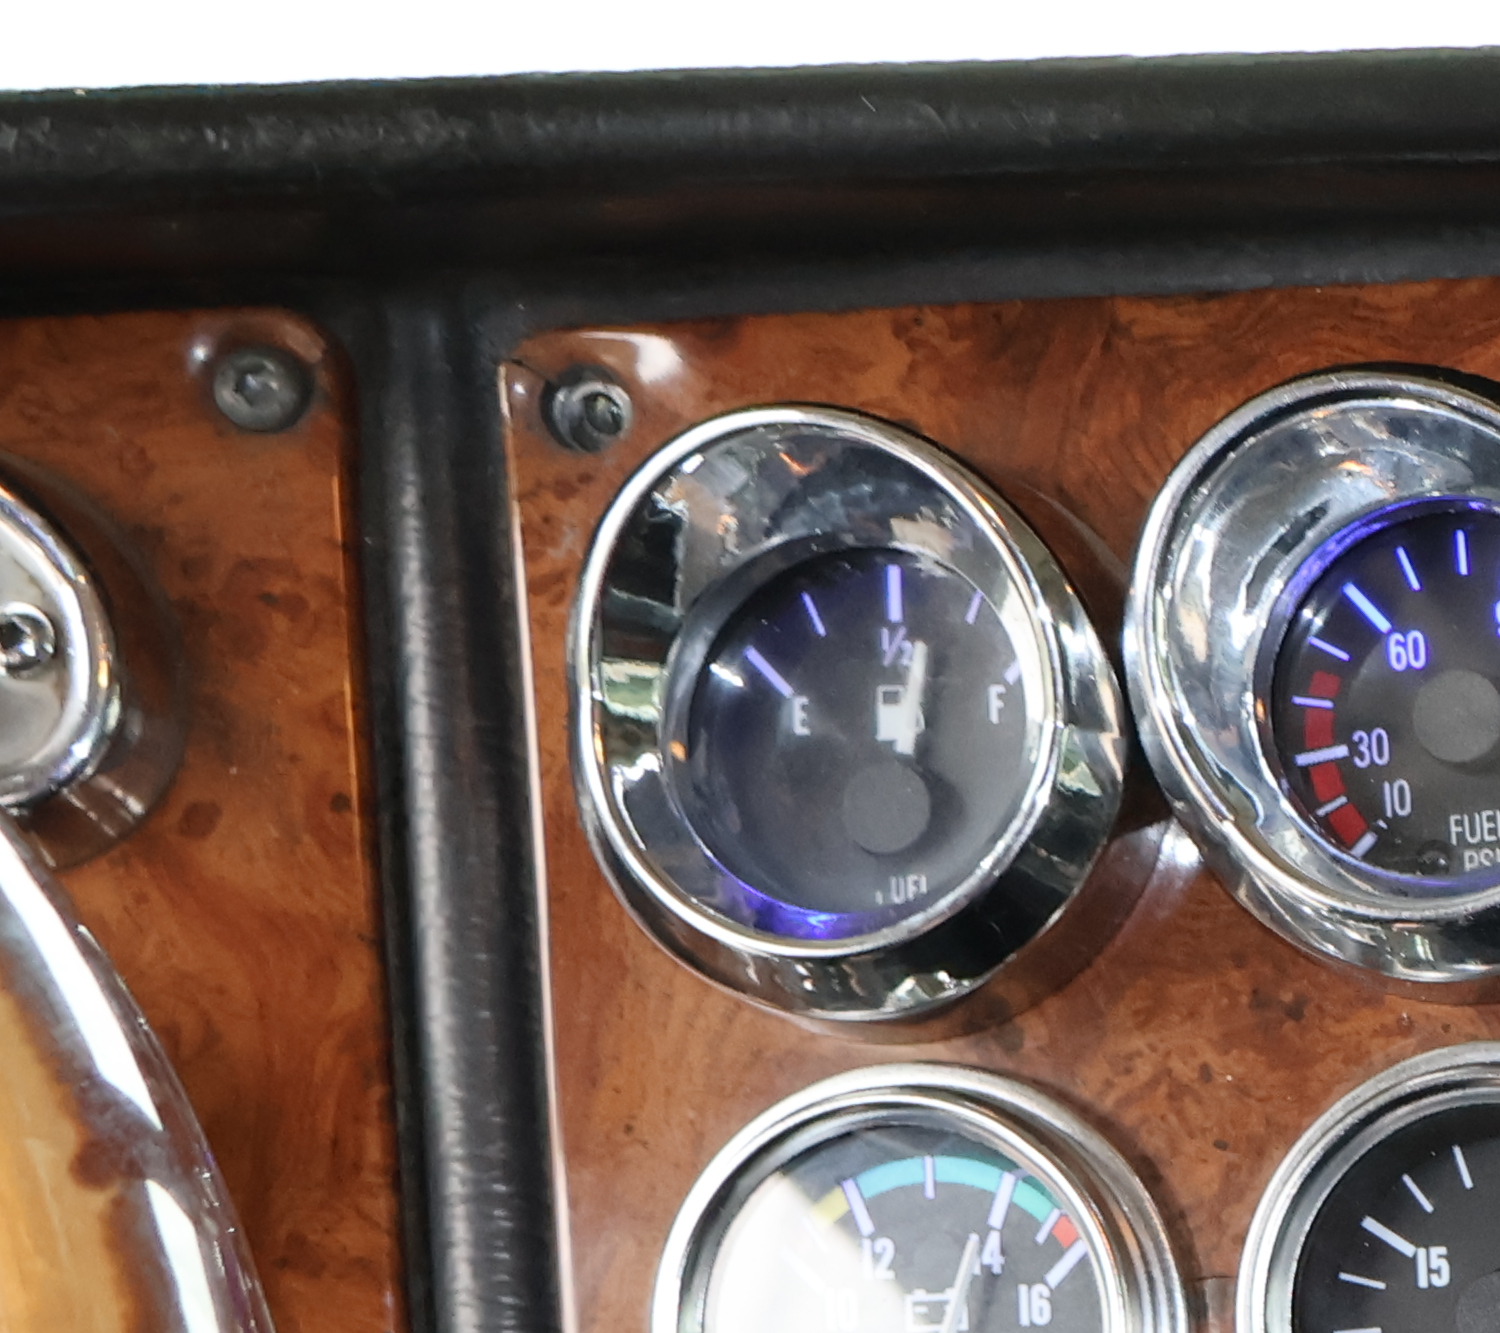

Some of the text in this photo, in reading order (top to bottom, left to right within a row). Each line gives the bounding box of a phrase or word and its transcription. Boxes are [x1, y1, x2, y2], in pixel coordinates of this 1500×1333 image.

[1388, 630, 1428, 670] 60
[792, 697, 811, 736] E
[989, 684, 1006, 725] F
[1352, 727, 1390, 768] 30
[1383, 779, 1411, 817] 10
[860, 1238, 896, 1281] 12
[1415, 1246, 1450, 1289] 15
[1018, 1283, 1052, 1326] 16
